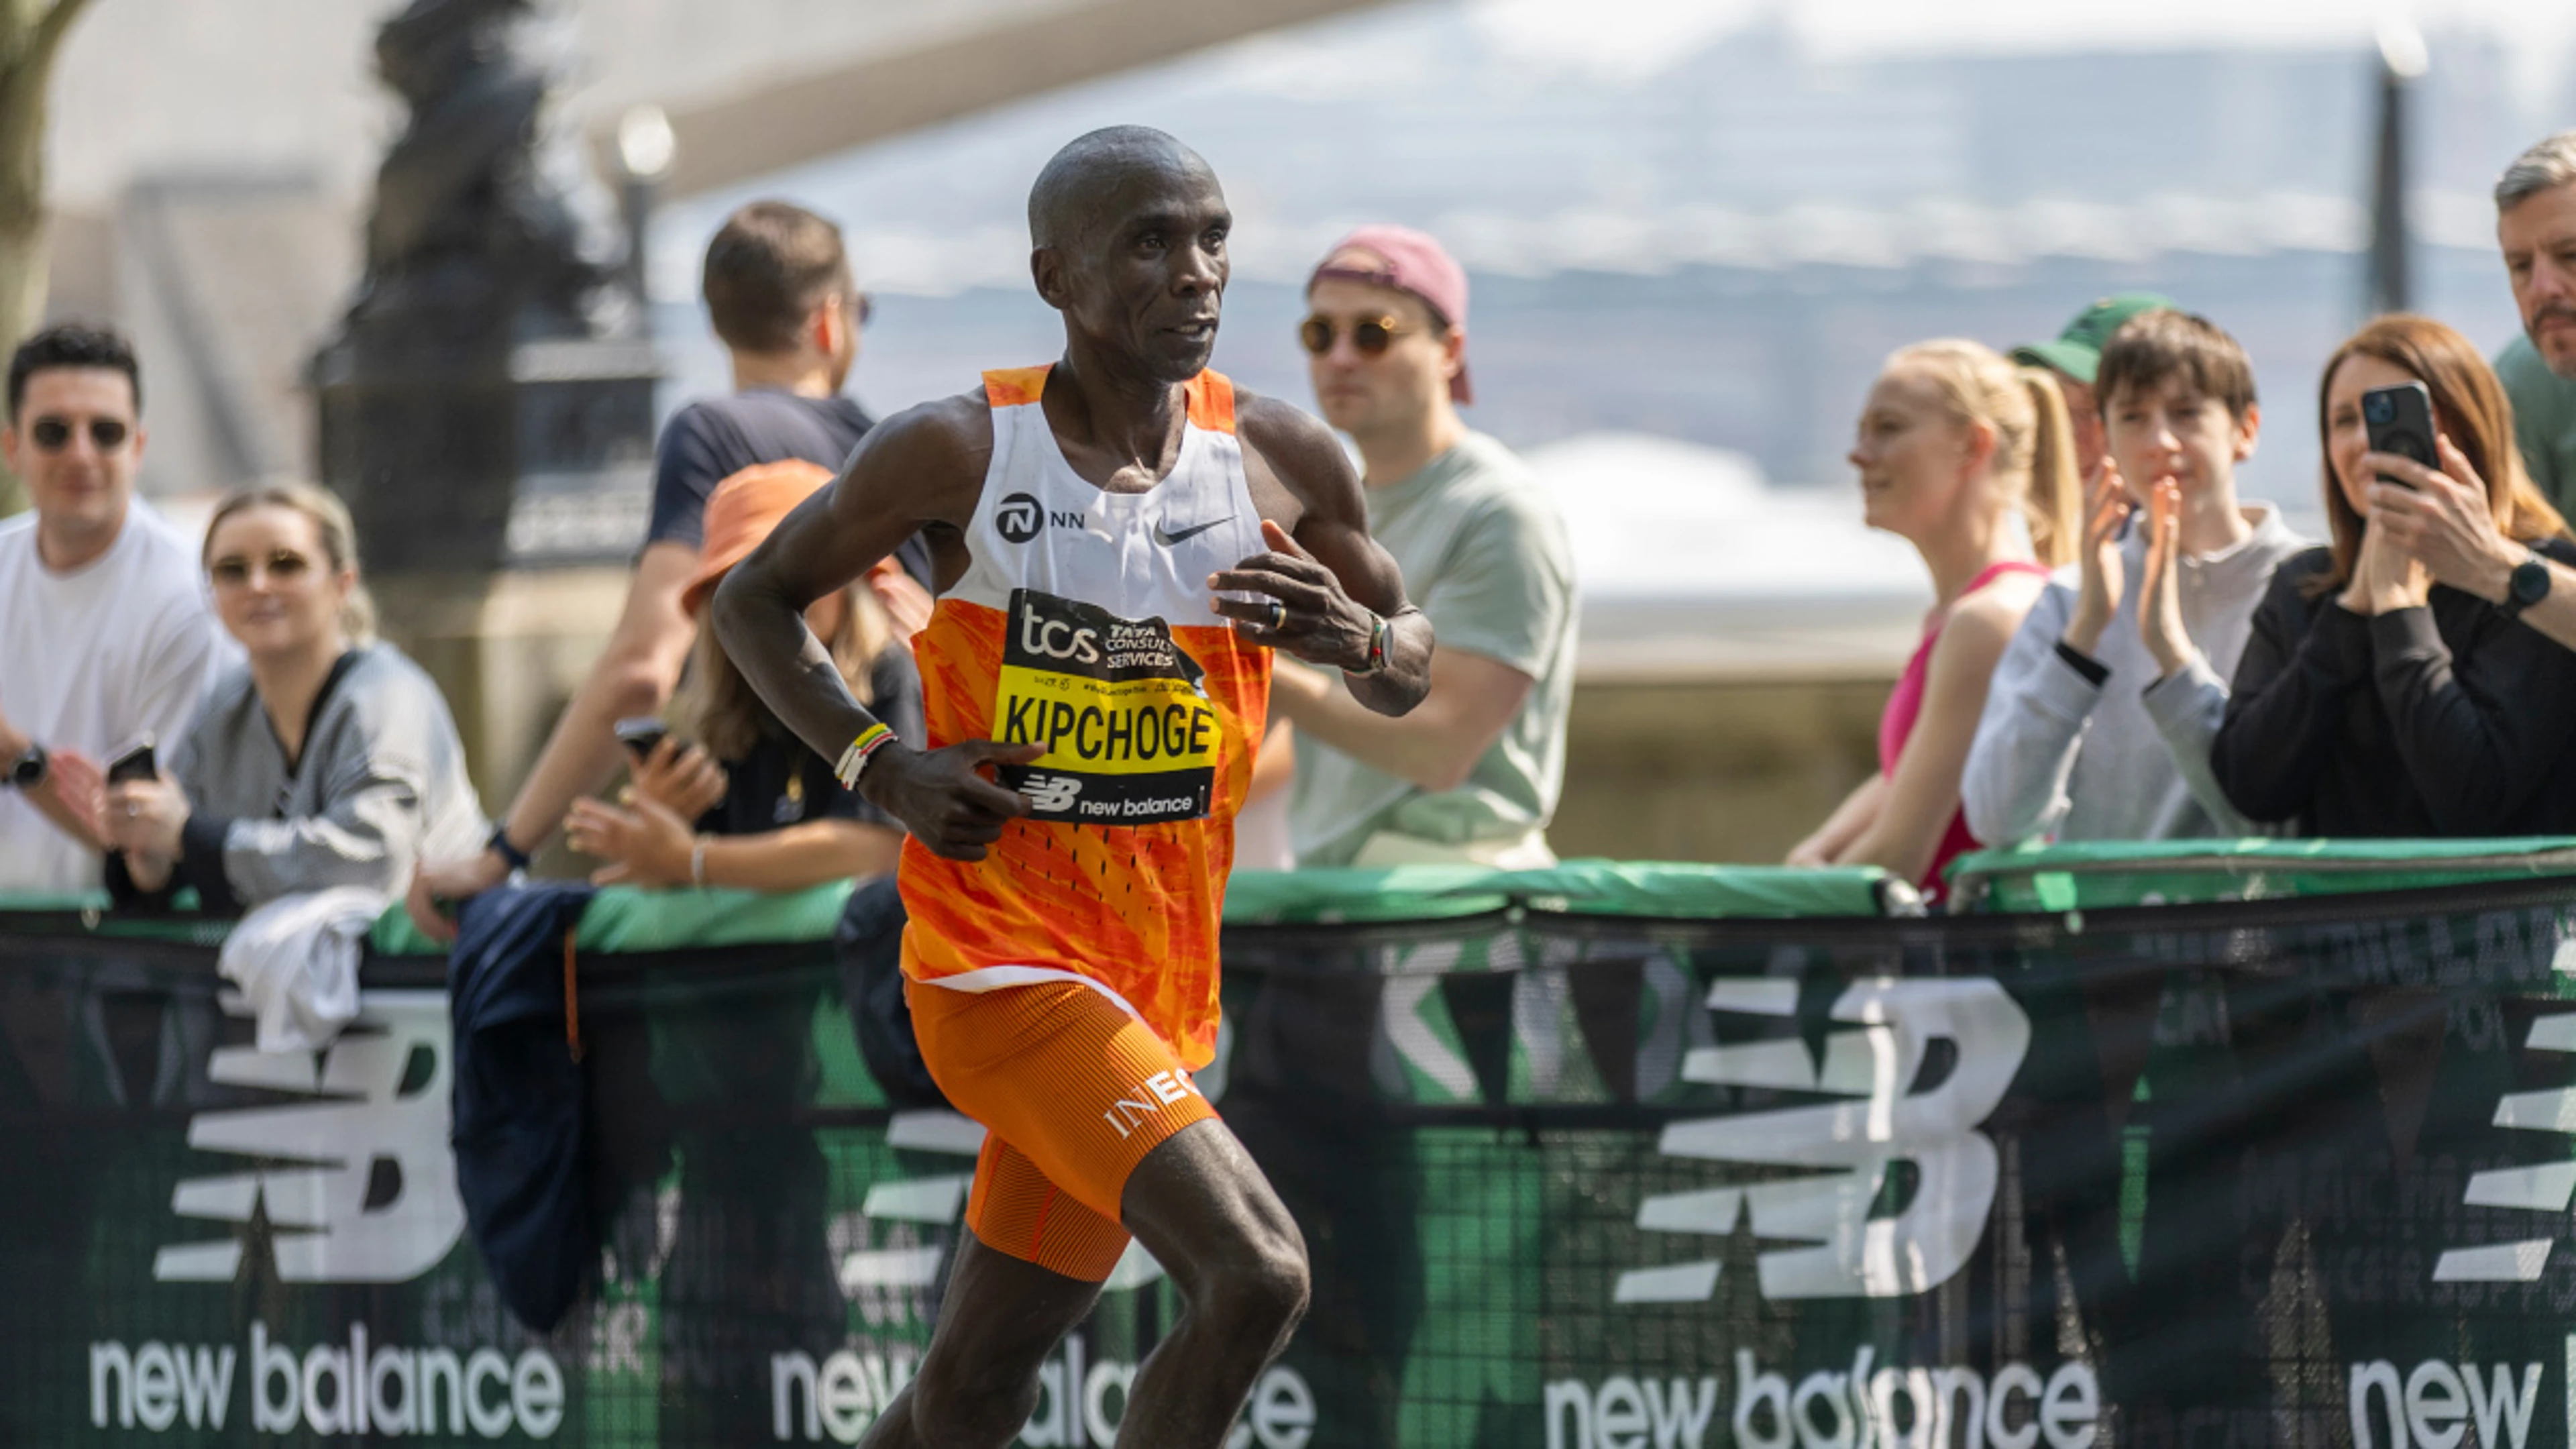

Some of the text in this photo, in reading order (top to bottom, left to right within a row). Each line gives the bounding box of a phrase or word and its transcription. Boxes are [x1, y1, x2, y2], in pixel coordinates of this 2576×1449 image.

[1050, 511, 1085, 529] NN
[1022, 603, 1099, 664] tcs
[1107, 651, 1173, 668] SERVICES
[1110, 624, 1156, 638] TATA
[1004, 695, 1214, 761] KIPCHOGE
[1079, 796, 1193, 816] new balance
[89, 1338, 237, 1431] new
[249, 1319, 566, 1440] balance
[1544, 1345, 2100, 1449] new balance
[2349, 1358, 2544, 1449] new
